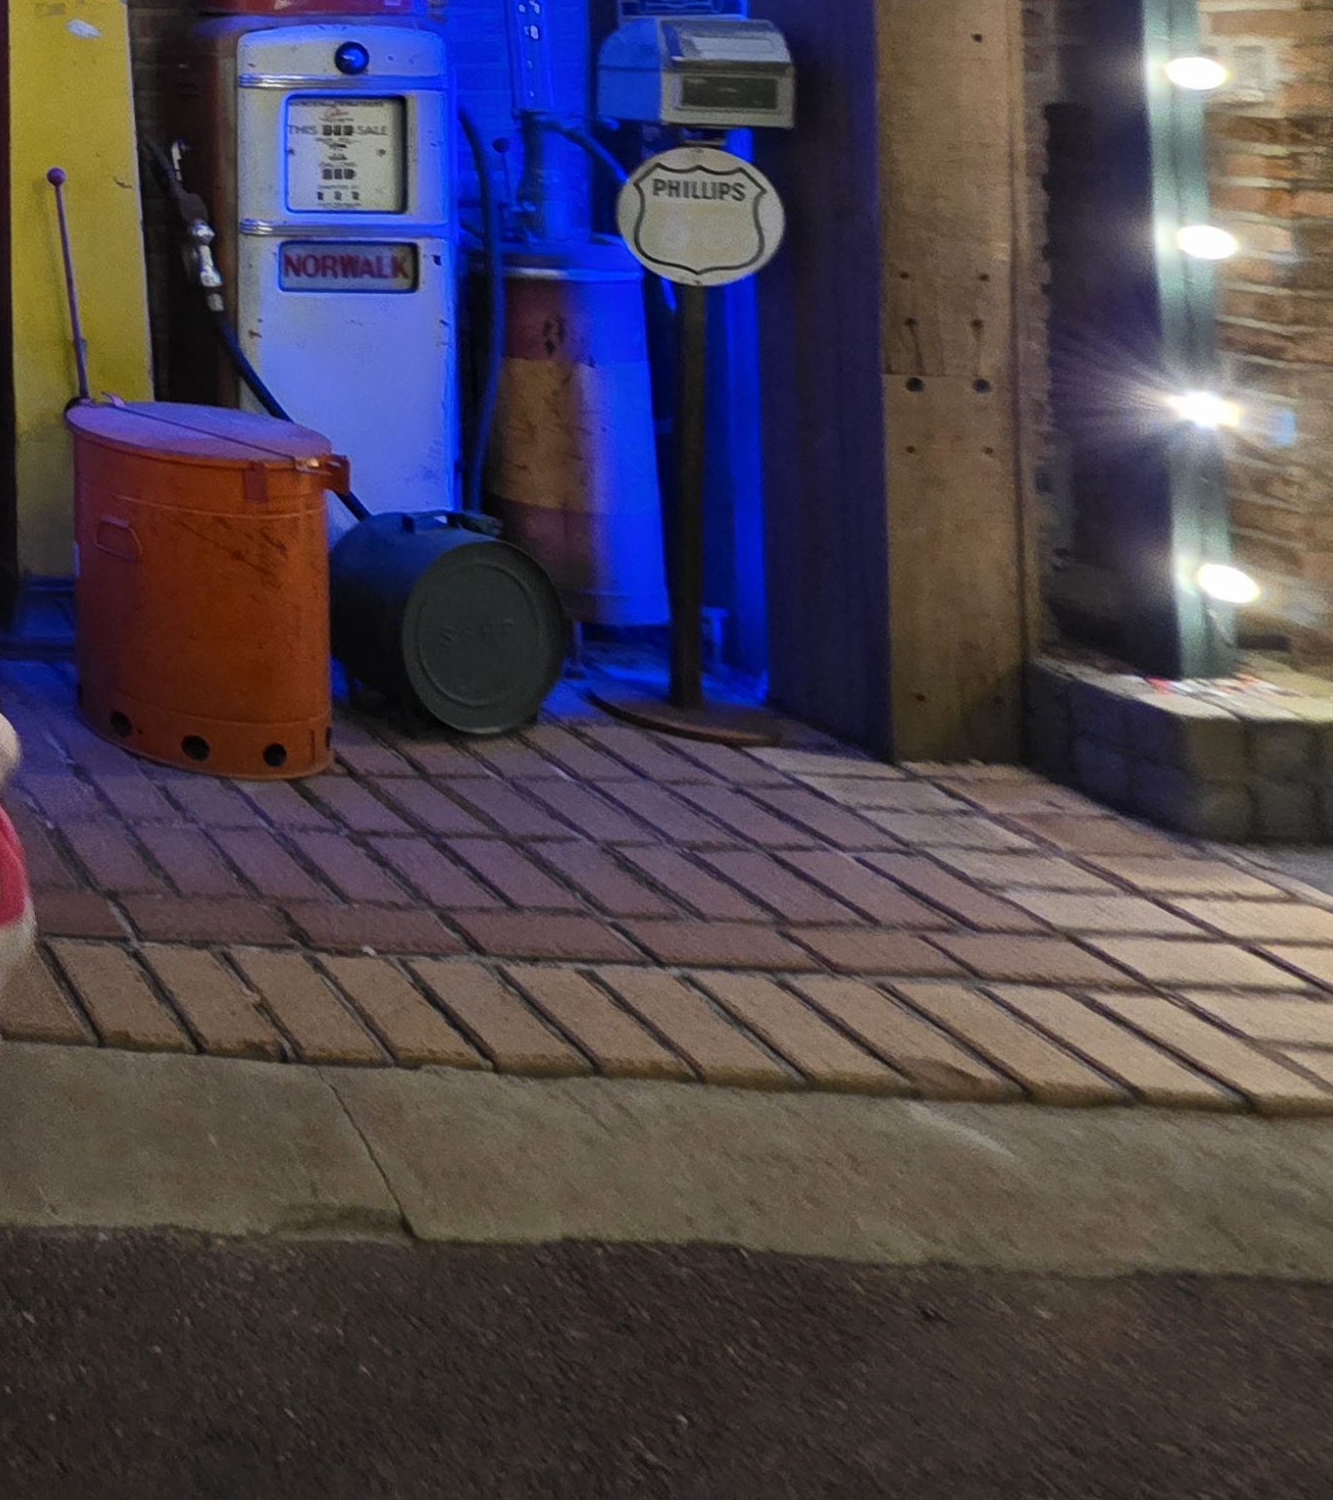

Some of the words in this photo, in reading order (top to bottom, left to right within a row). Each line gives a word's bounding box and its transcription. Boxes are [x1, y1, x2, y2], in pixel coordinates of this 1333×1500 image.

[287, 124, 319, 135] THIS
[356, 124, 388, 136] SALE
[652, 178, 747, 202] PHILLIPS
[284, 253, 410, 279] NORWALK
